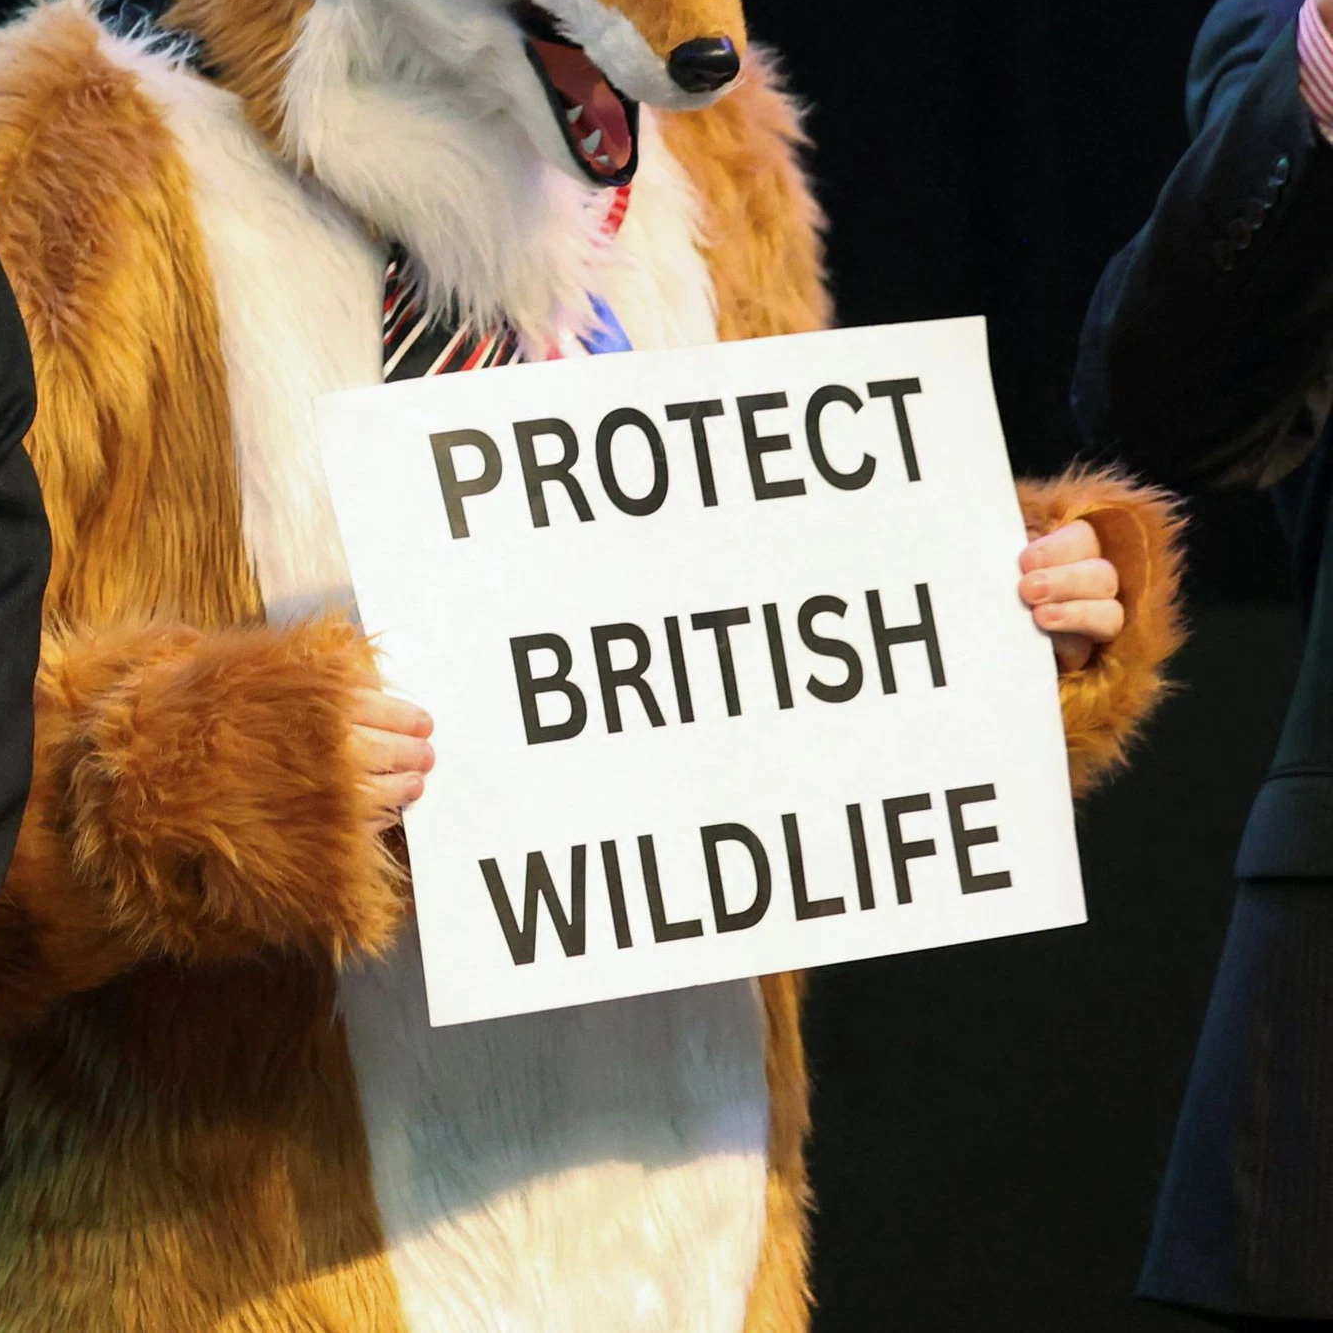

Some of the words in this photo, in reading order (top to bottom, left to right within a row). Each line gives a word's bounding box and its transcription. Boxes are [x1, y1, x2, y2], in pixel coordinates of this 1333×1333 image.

[429, 377, 923, 539] PROTECT
[509, 582, 947, 746] BRITISH
[478, 783, 1013, 966] WILDLIFE
